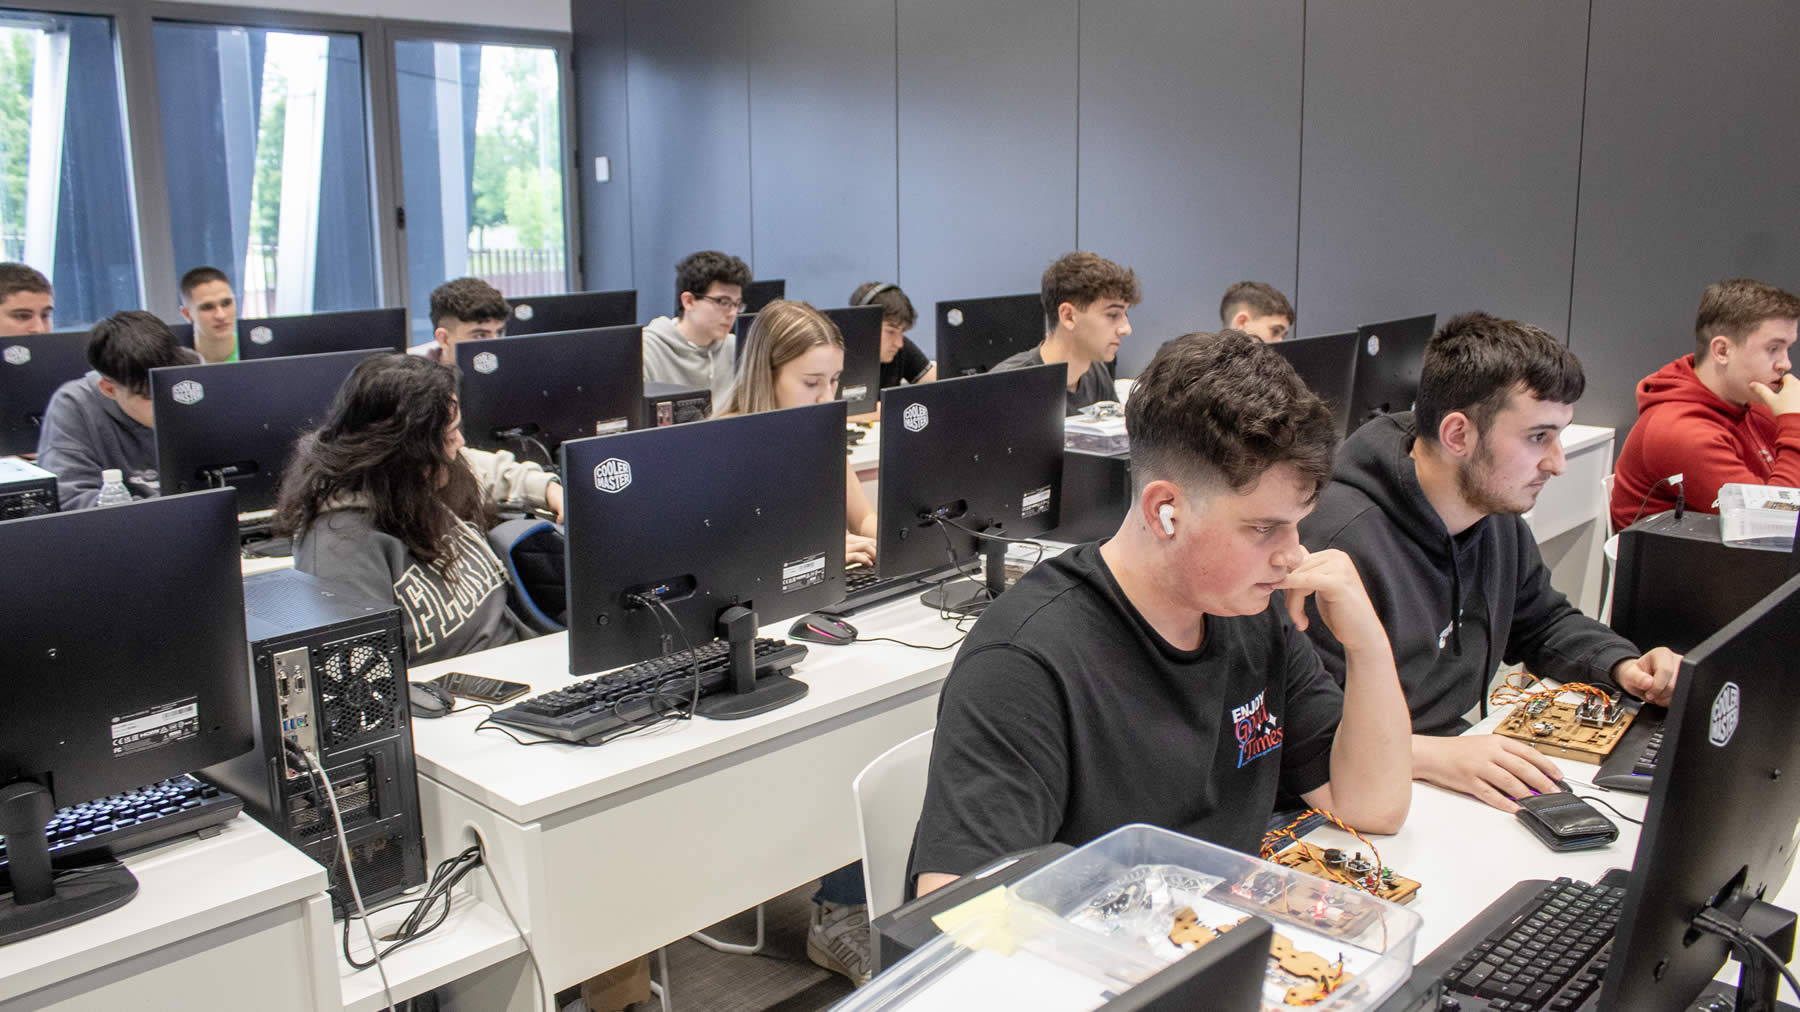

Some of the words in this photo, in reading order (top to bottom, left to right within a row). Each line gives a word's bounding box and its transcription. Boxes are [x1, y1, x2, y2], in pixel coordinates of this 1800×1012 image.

[596, 460, 629, 477] COOLER
[597, 473, 630, 490] MASTER
[1232, 690, 1265, 724] ENJOY
[1711, 686, 1738, 722] COOLER
[1710, 705, 1738, 742] MASTER
[1243, 726, 1283, 760] Times
